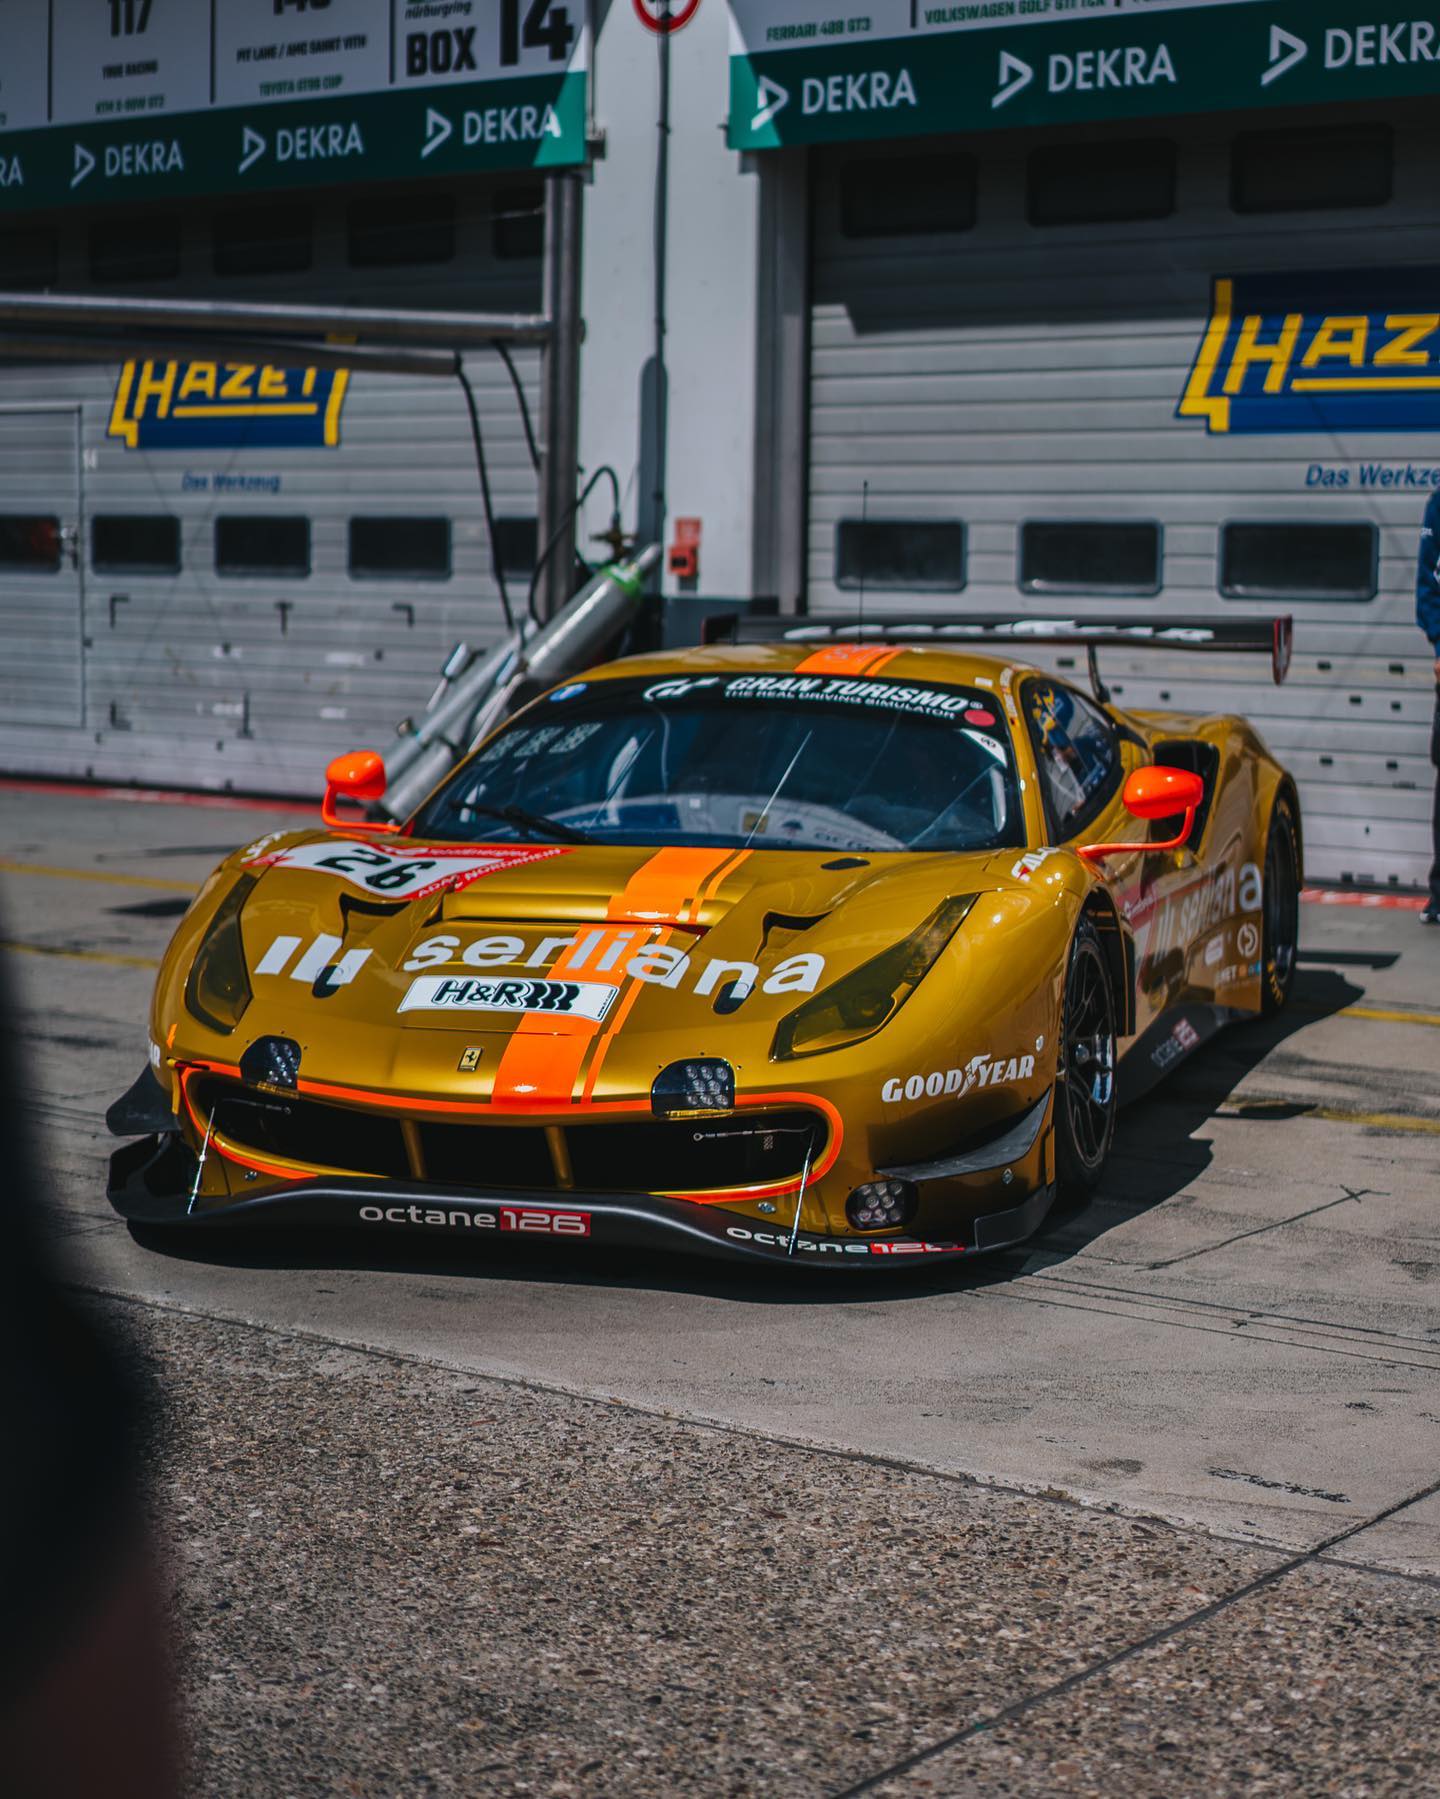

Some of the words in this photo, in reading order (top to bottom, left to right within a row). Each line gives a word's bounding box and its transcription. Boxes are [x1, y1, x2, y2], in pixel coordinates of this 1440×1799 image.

[766, 23, 818, 42] FERRARI
[924, 2, 1015, 25] VOLKSWAGEN
[406, 26, 477, 77] BOX
[500, 0, 574, 67] 14
[1324, 20, 1440, 69] DEKR
[1049, 43, 1177, 92] DEKRA
[802, 69, 917, 114] DEKRA
[276, 122, 364, 162] DEKRA
[463, 103, 562, 145] DEKRA
[105, 140, 184, 178] DEKRA
[1305, 464, 1349, 487] Das
[725, 690, 753, 699] THE
[756, 690, 794, 699] REAL
[799, 692, 862, 705] DRIVING
[864, 697, 956, 720] SIMULATOR
[726, 676, 823, 692] GRAN
[824, 680, 970, 711] TURISMO
[314, 847, 436, 890] 26
[403, 930, 826, 996] serliana
[432, 979, 522, 1010] H&R
